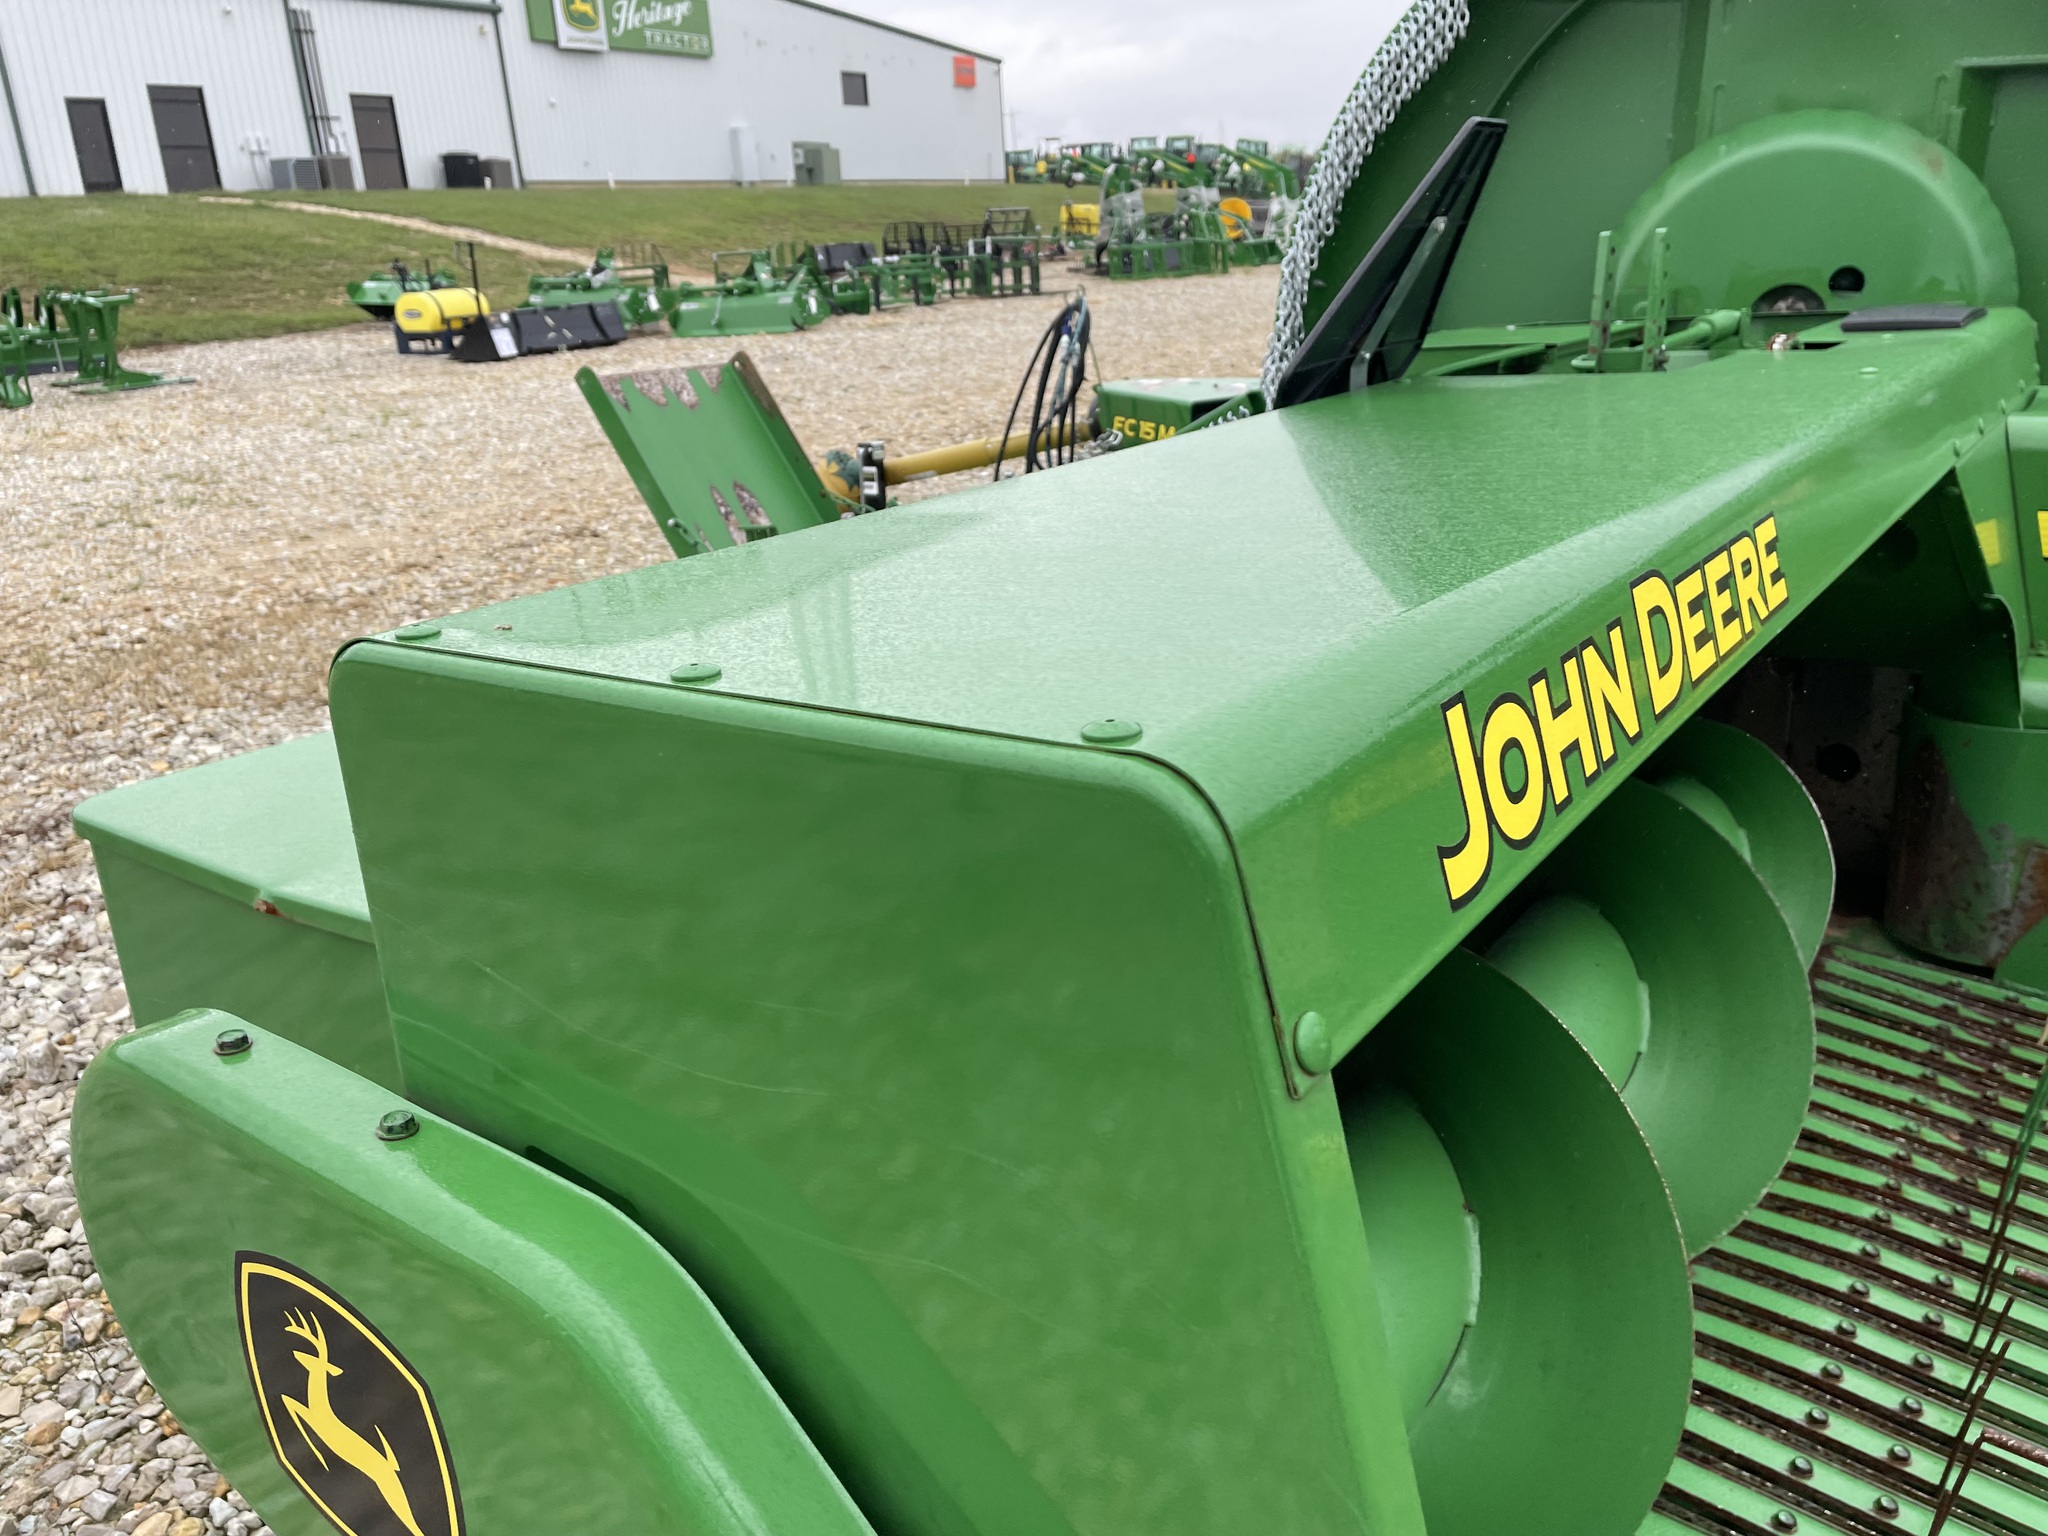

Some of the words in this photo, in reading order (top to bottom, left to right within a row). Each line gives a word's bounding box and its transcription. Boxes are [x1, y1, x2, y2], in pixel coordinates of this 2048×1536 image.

[611, 0, 692, 37] Heritage
[645, 30, 710, 50] TRACTOR
[1437, 616, 1643, 913] JOHN
[1629, 511, 1789, 724] DEERE
